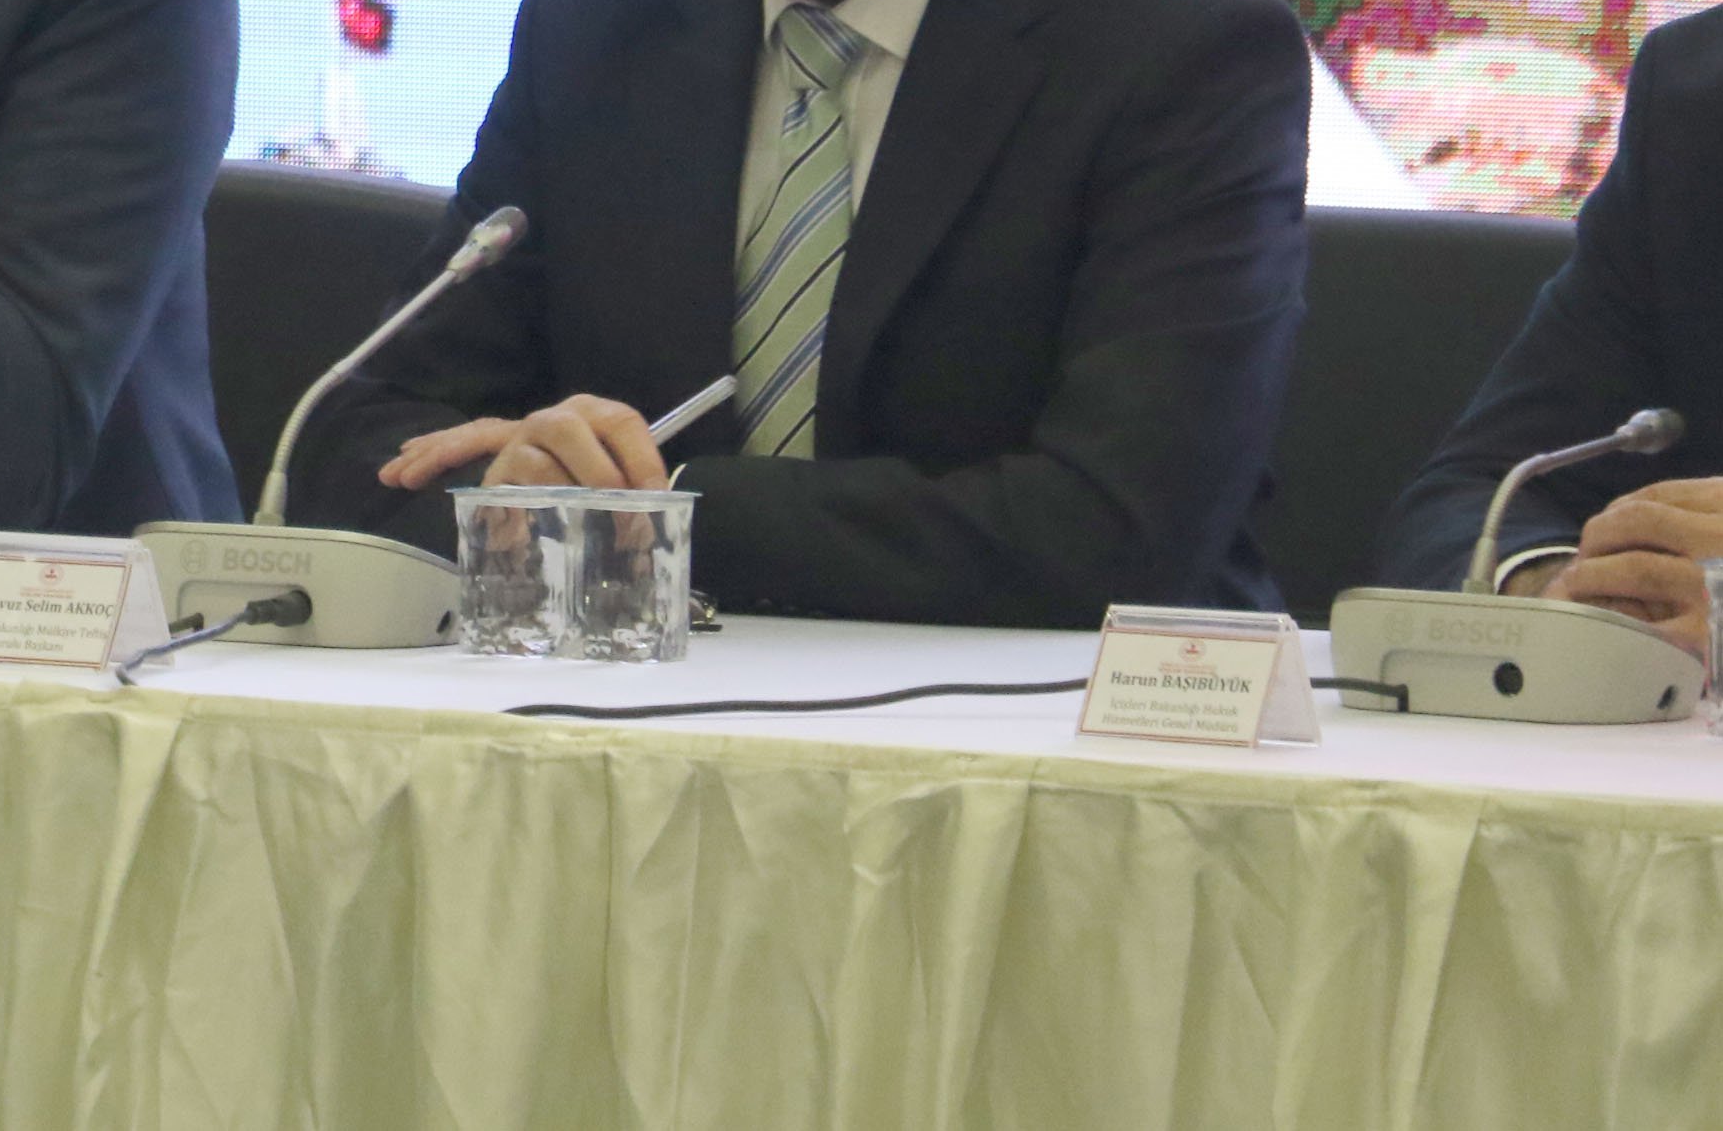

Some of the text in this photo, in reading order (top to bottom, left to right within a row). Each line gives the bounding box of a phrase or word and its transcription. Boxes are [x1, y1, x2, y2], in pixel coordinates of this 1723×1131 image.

[222, 545, 313, 574] BOSCH
[25, 598, 63, 614] Selim
[66, 601, 115, 620] AKKOÇ
[1426, 619, 1524, 646] BOSCH
[1110, 670, 1158, 687] Harun
